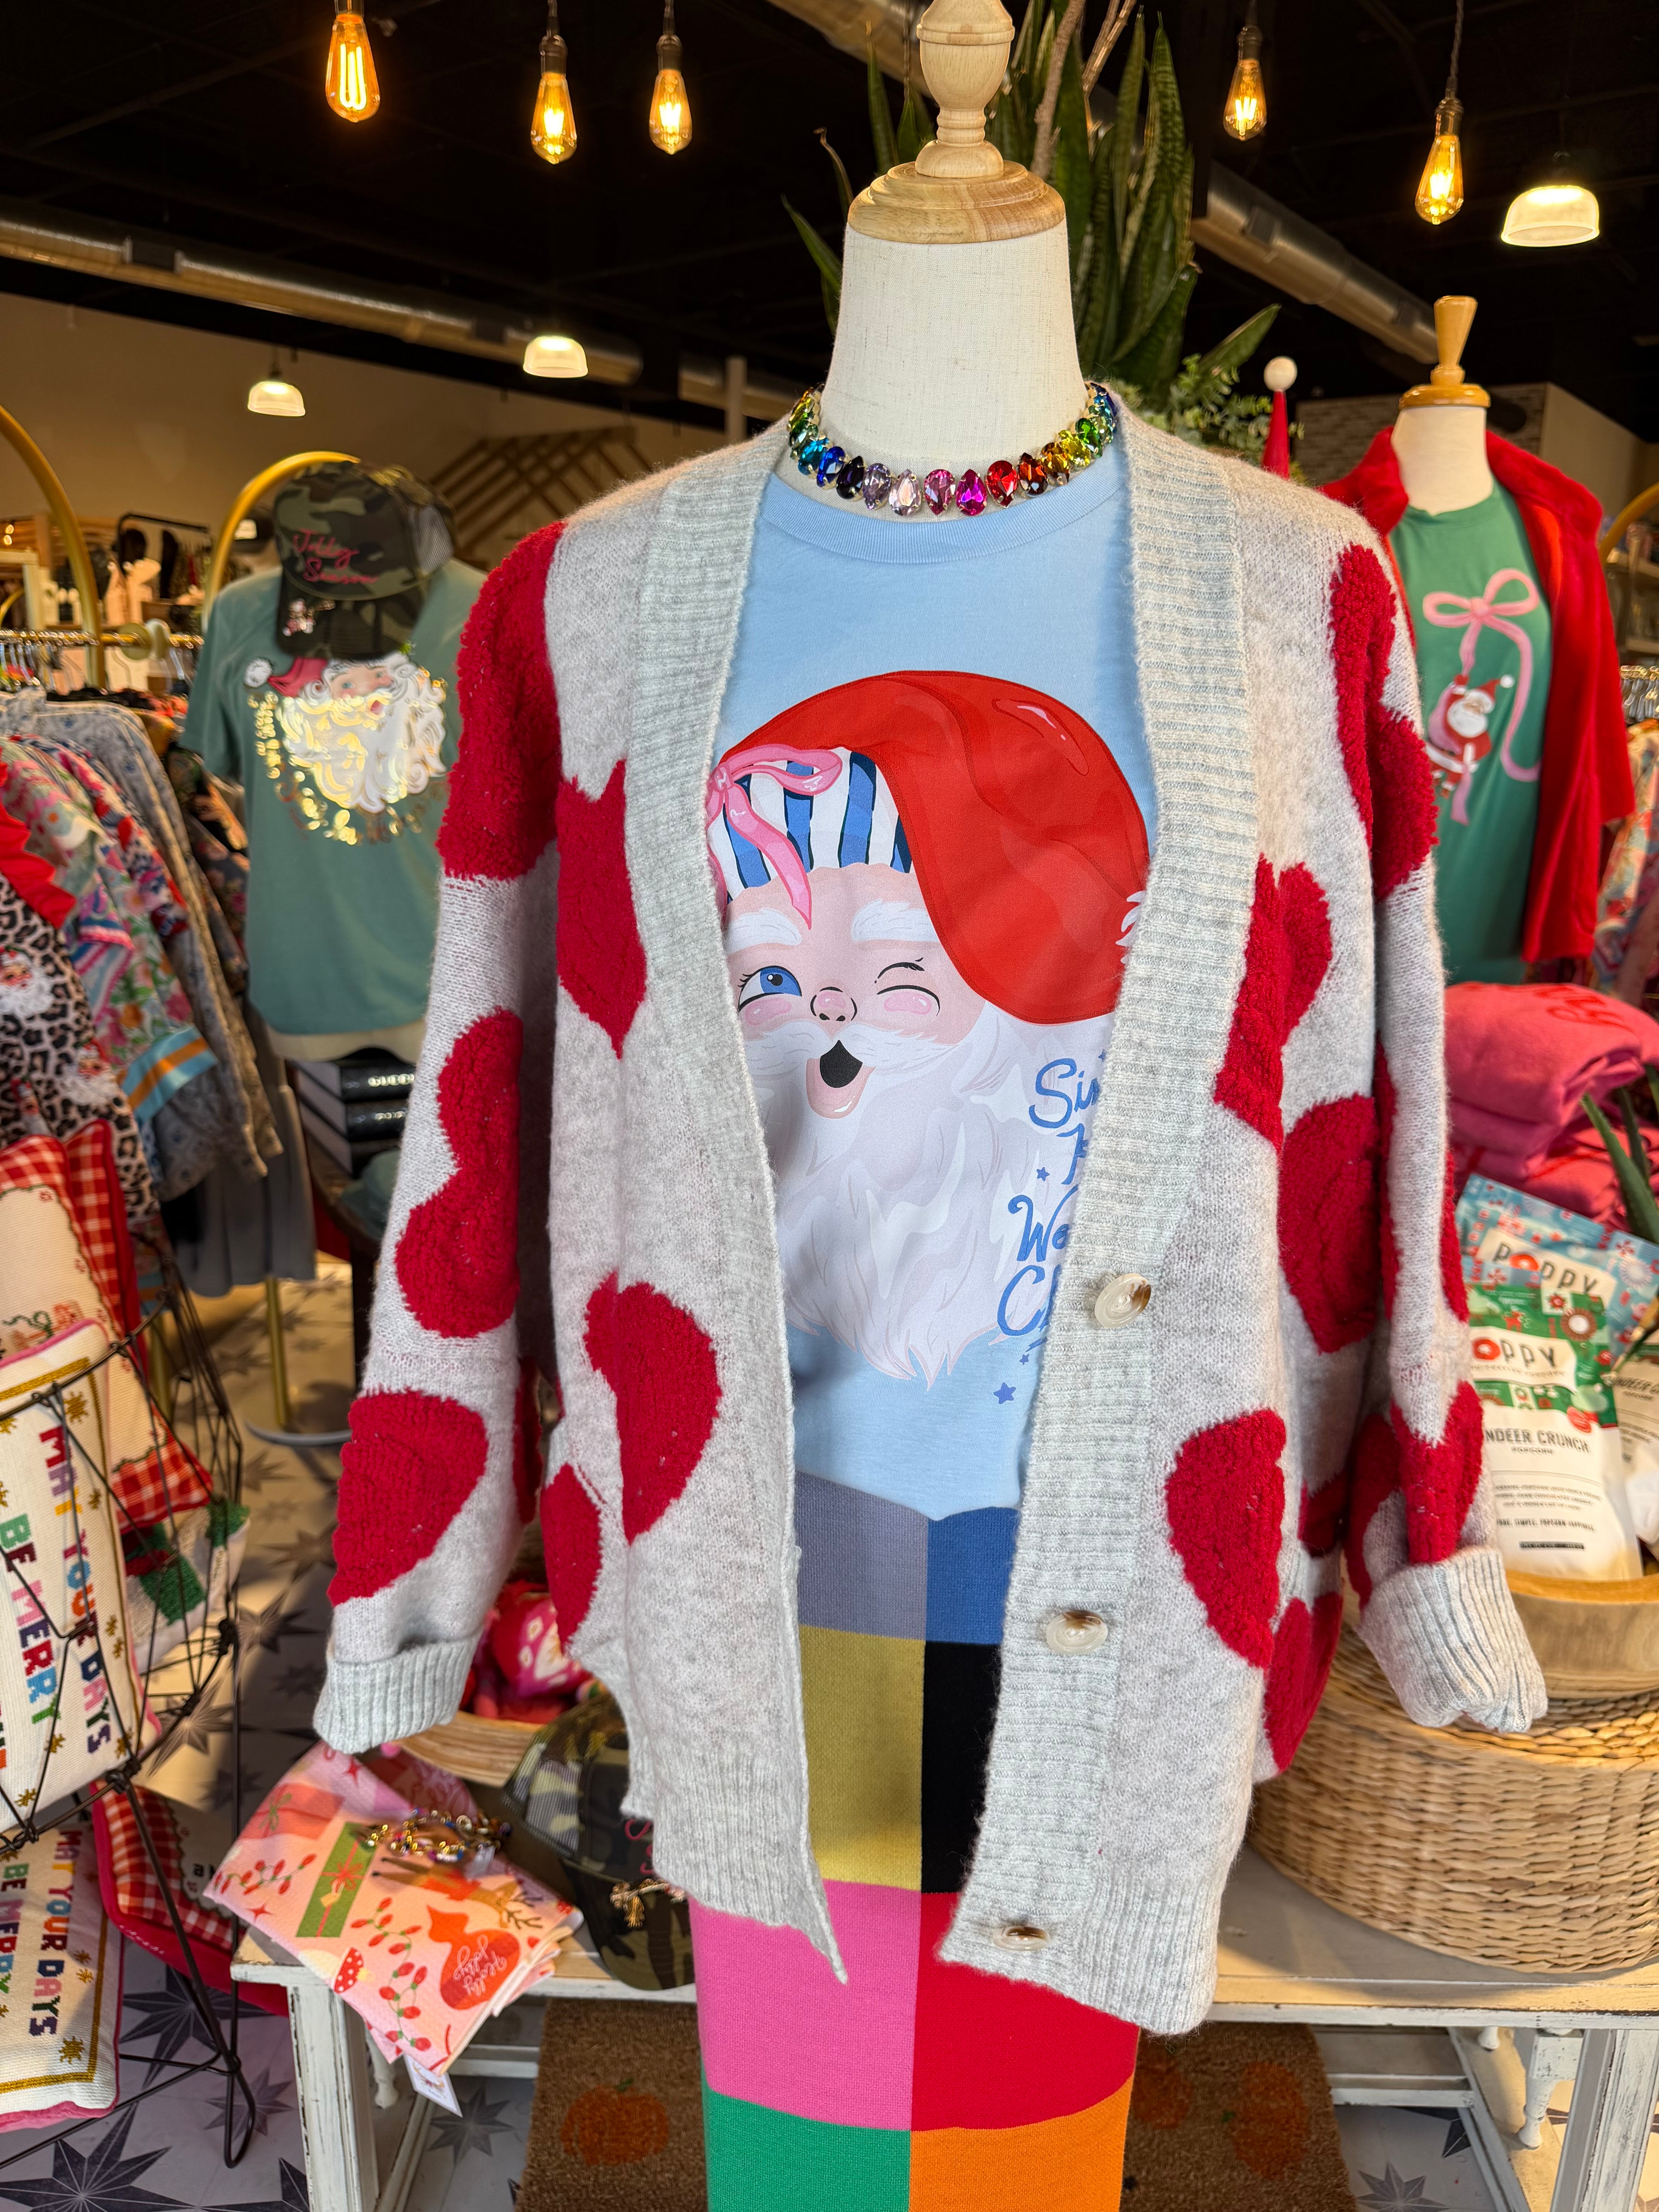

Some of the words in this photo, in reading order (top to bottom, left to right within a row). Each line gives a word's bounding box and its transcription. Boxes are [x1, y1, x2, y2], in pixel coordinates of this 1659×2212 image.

[293, 527, 359, 570] Jolly
[1485, 1427, 1532, 1444] NDEER
[1537, 1429, 1590, 1454] CRUNCH
[0, 1513, 37, 1572] BE
[39, 1425, 83, 1516] MAY
[80, 1649, 111, 1753] DAYS
[11, 1580, 61, 1724] MERRY
[1, 1863, 29, 1892] BE
[52, 1830, 82, 1875] MAY
[41, 1884, 74, 1951] YOUR
[29, 1960, 65, 2037] DAYS
[463, 1950, 507, 1996] Holly
